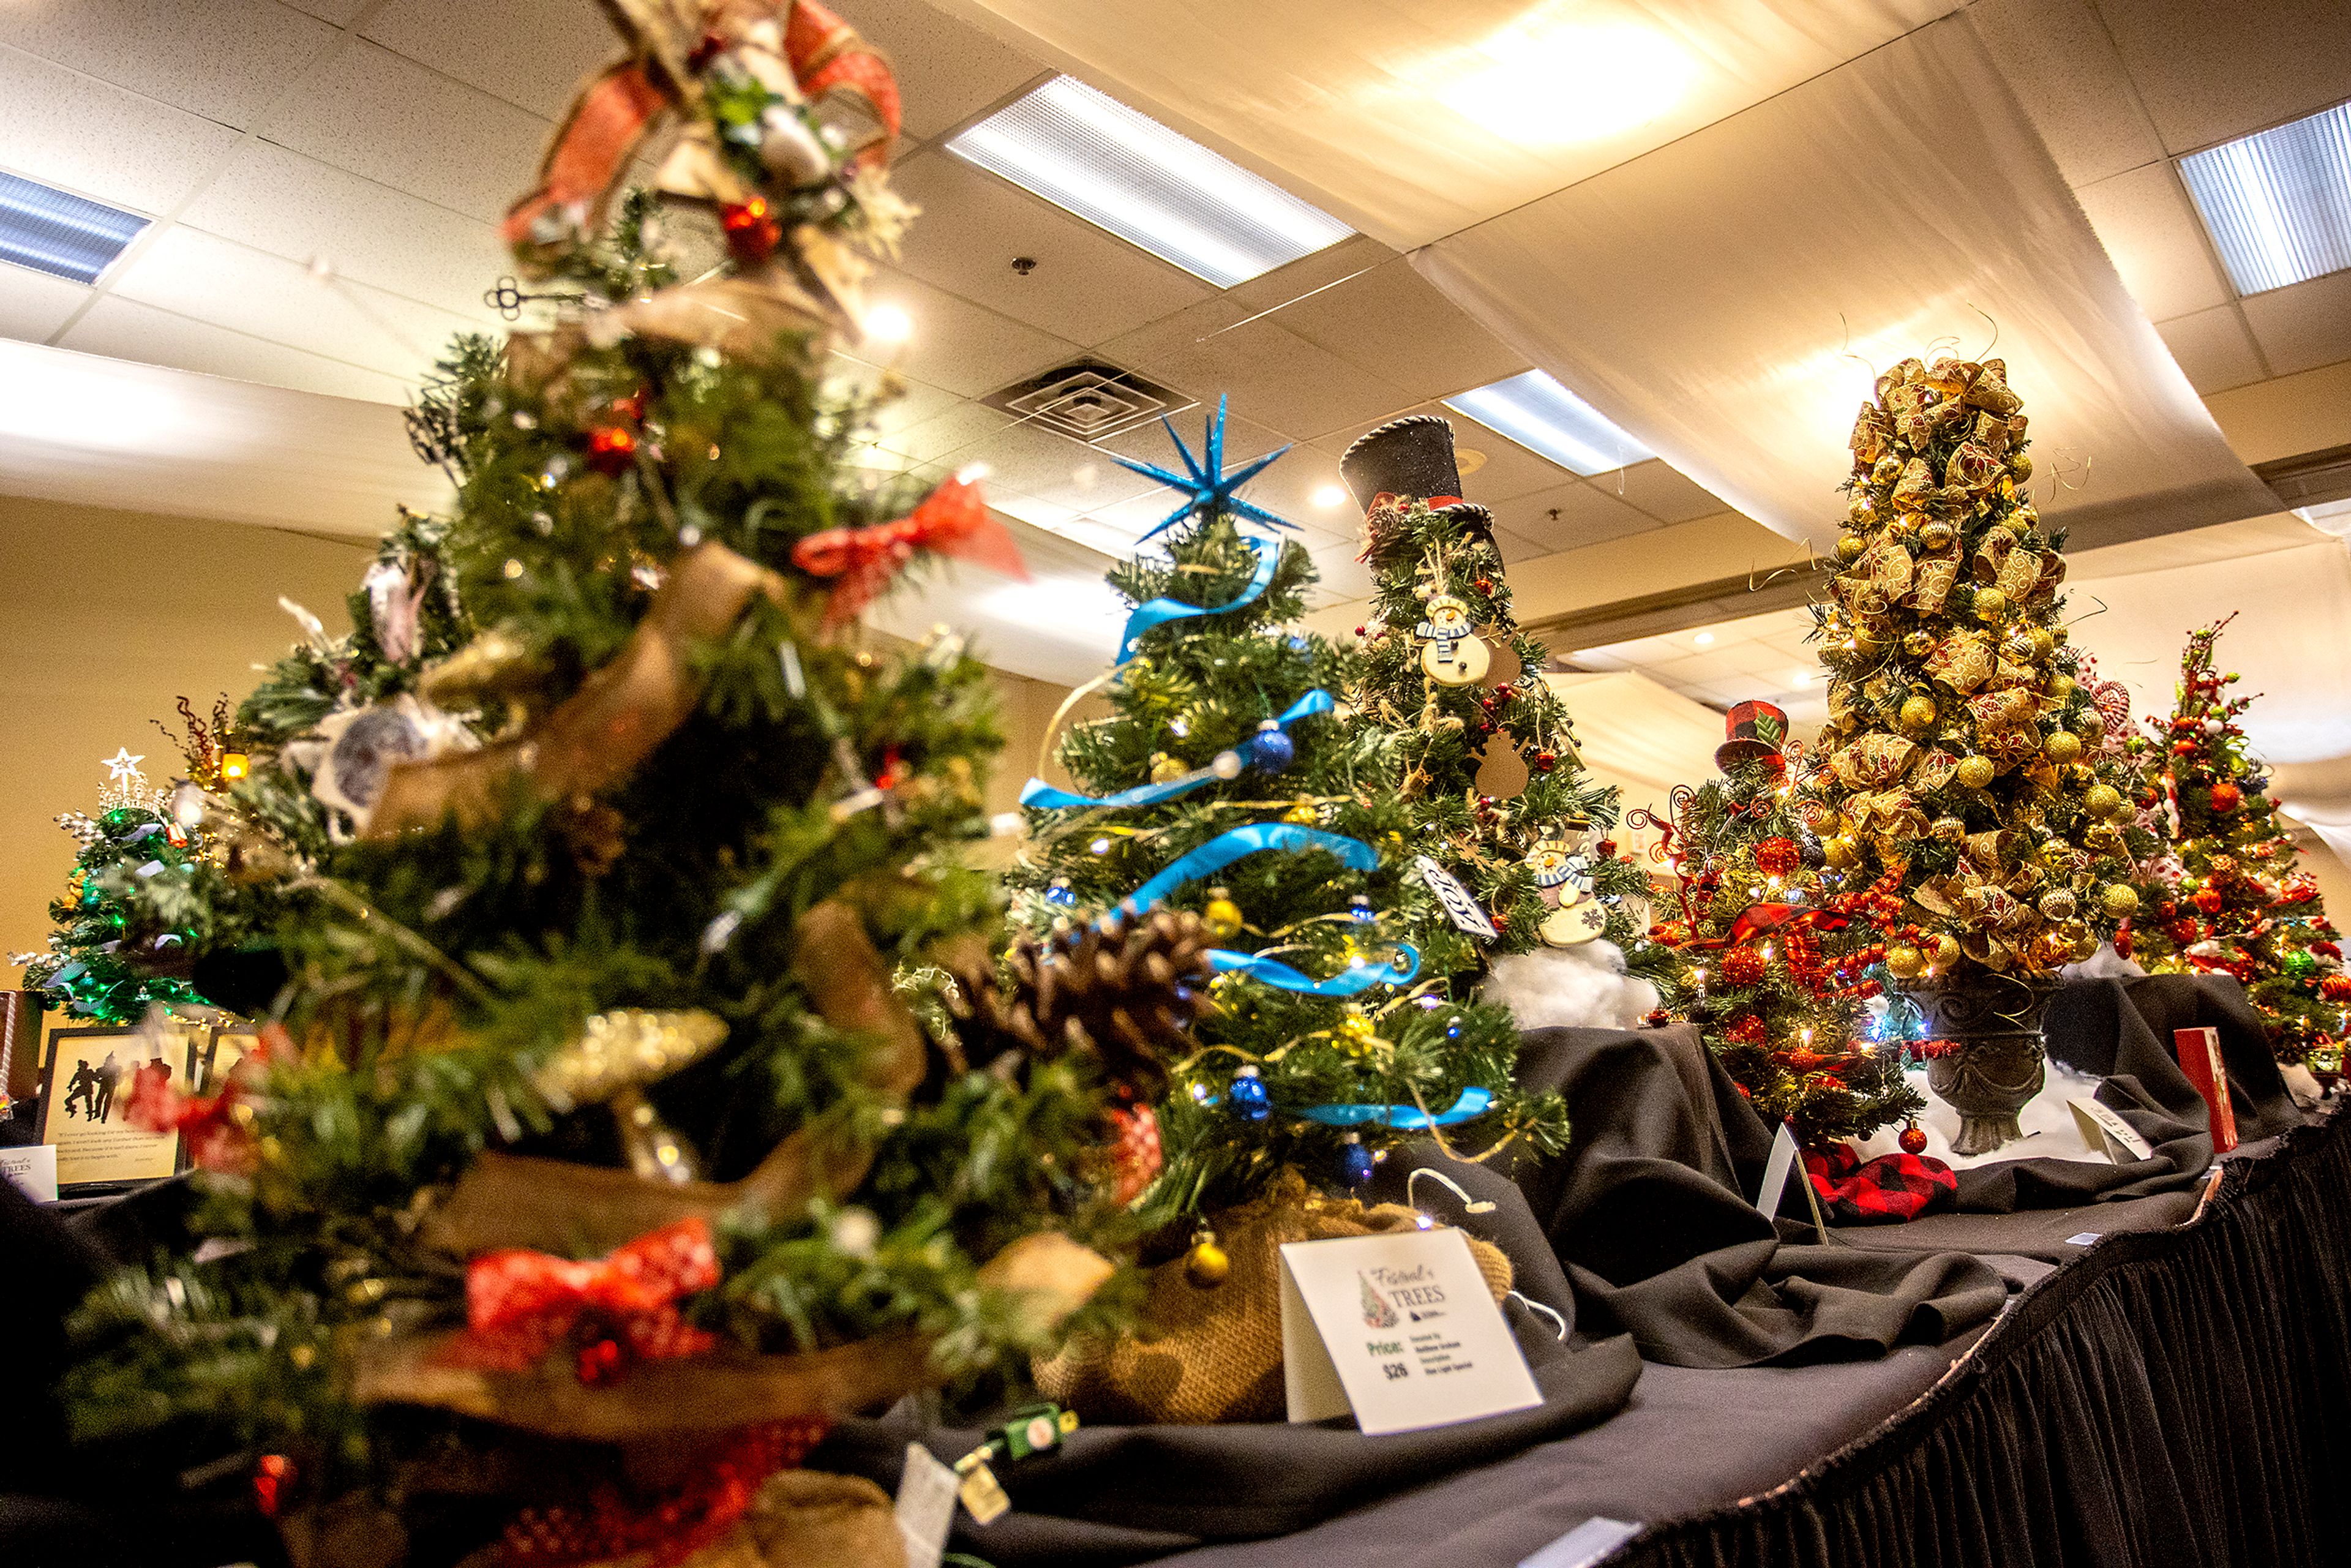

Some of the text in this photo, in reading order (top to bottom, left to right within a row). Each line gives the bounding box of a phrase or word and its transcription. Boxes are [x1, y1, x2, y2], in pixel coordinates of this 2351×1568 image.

[1428, 868, 1482, 929] JOY
[1387, 1285, 1445, 1308] TREES
[1366, 1341, 1404, 1356] Price:
